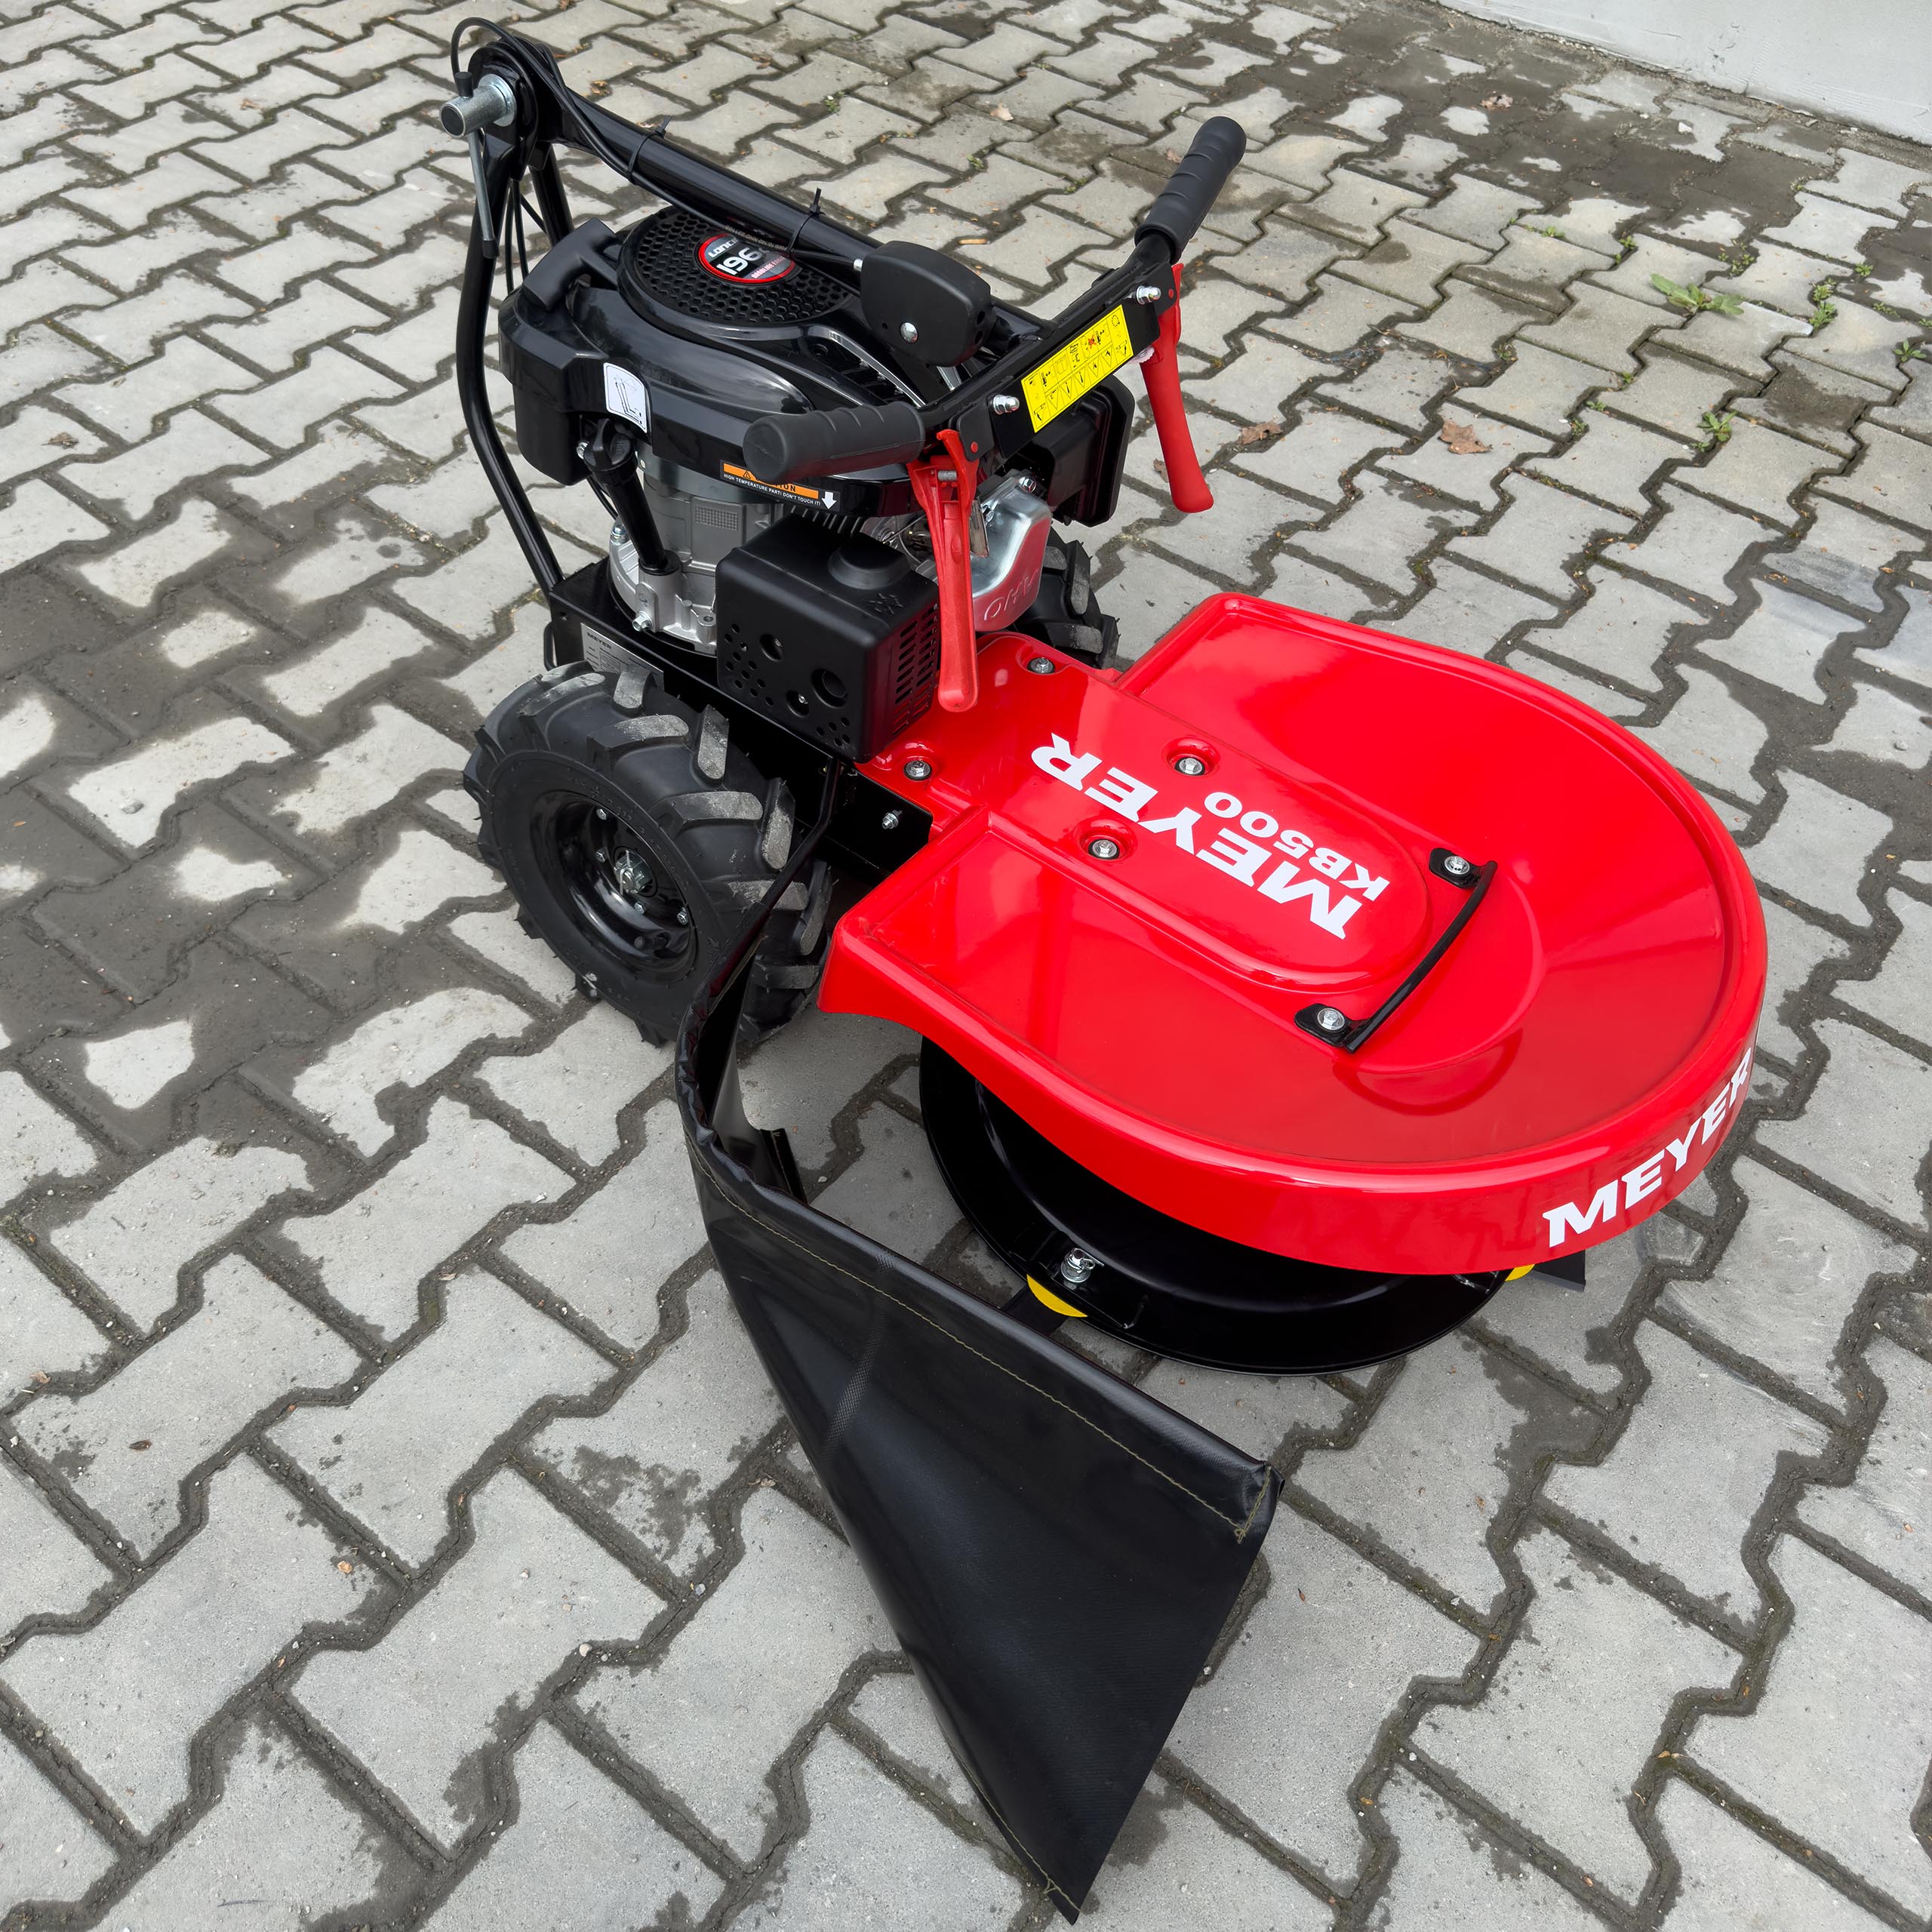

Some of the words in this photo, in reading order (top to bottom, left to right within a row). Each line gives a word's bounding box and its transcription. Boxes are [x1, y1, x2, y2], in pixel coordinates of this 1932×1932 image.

[736, 477, 768, 492] TEMPERATURE
[768, 488, 782, 496] PART!
[783, 491, 796, 500] DON'T
[798, 496, 813, 504] TOUCH
[587, 632, 611, 649] MEYER
[1031, 732, 1363, 940] MEYER
[1204, 791, 1390, 902] KB500
[1543, 1047, 1752, 1248] MEYER
